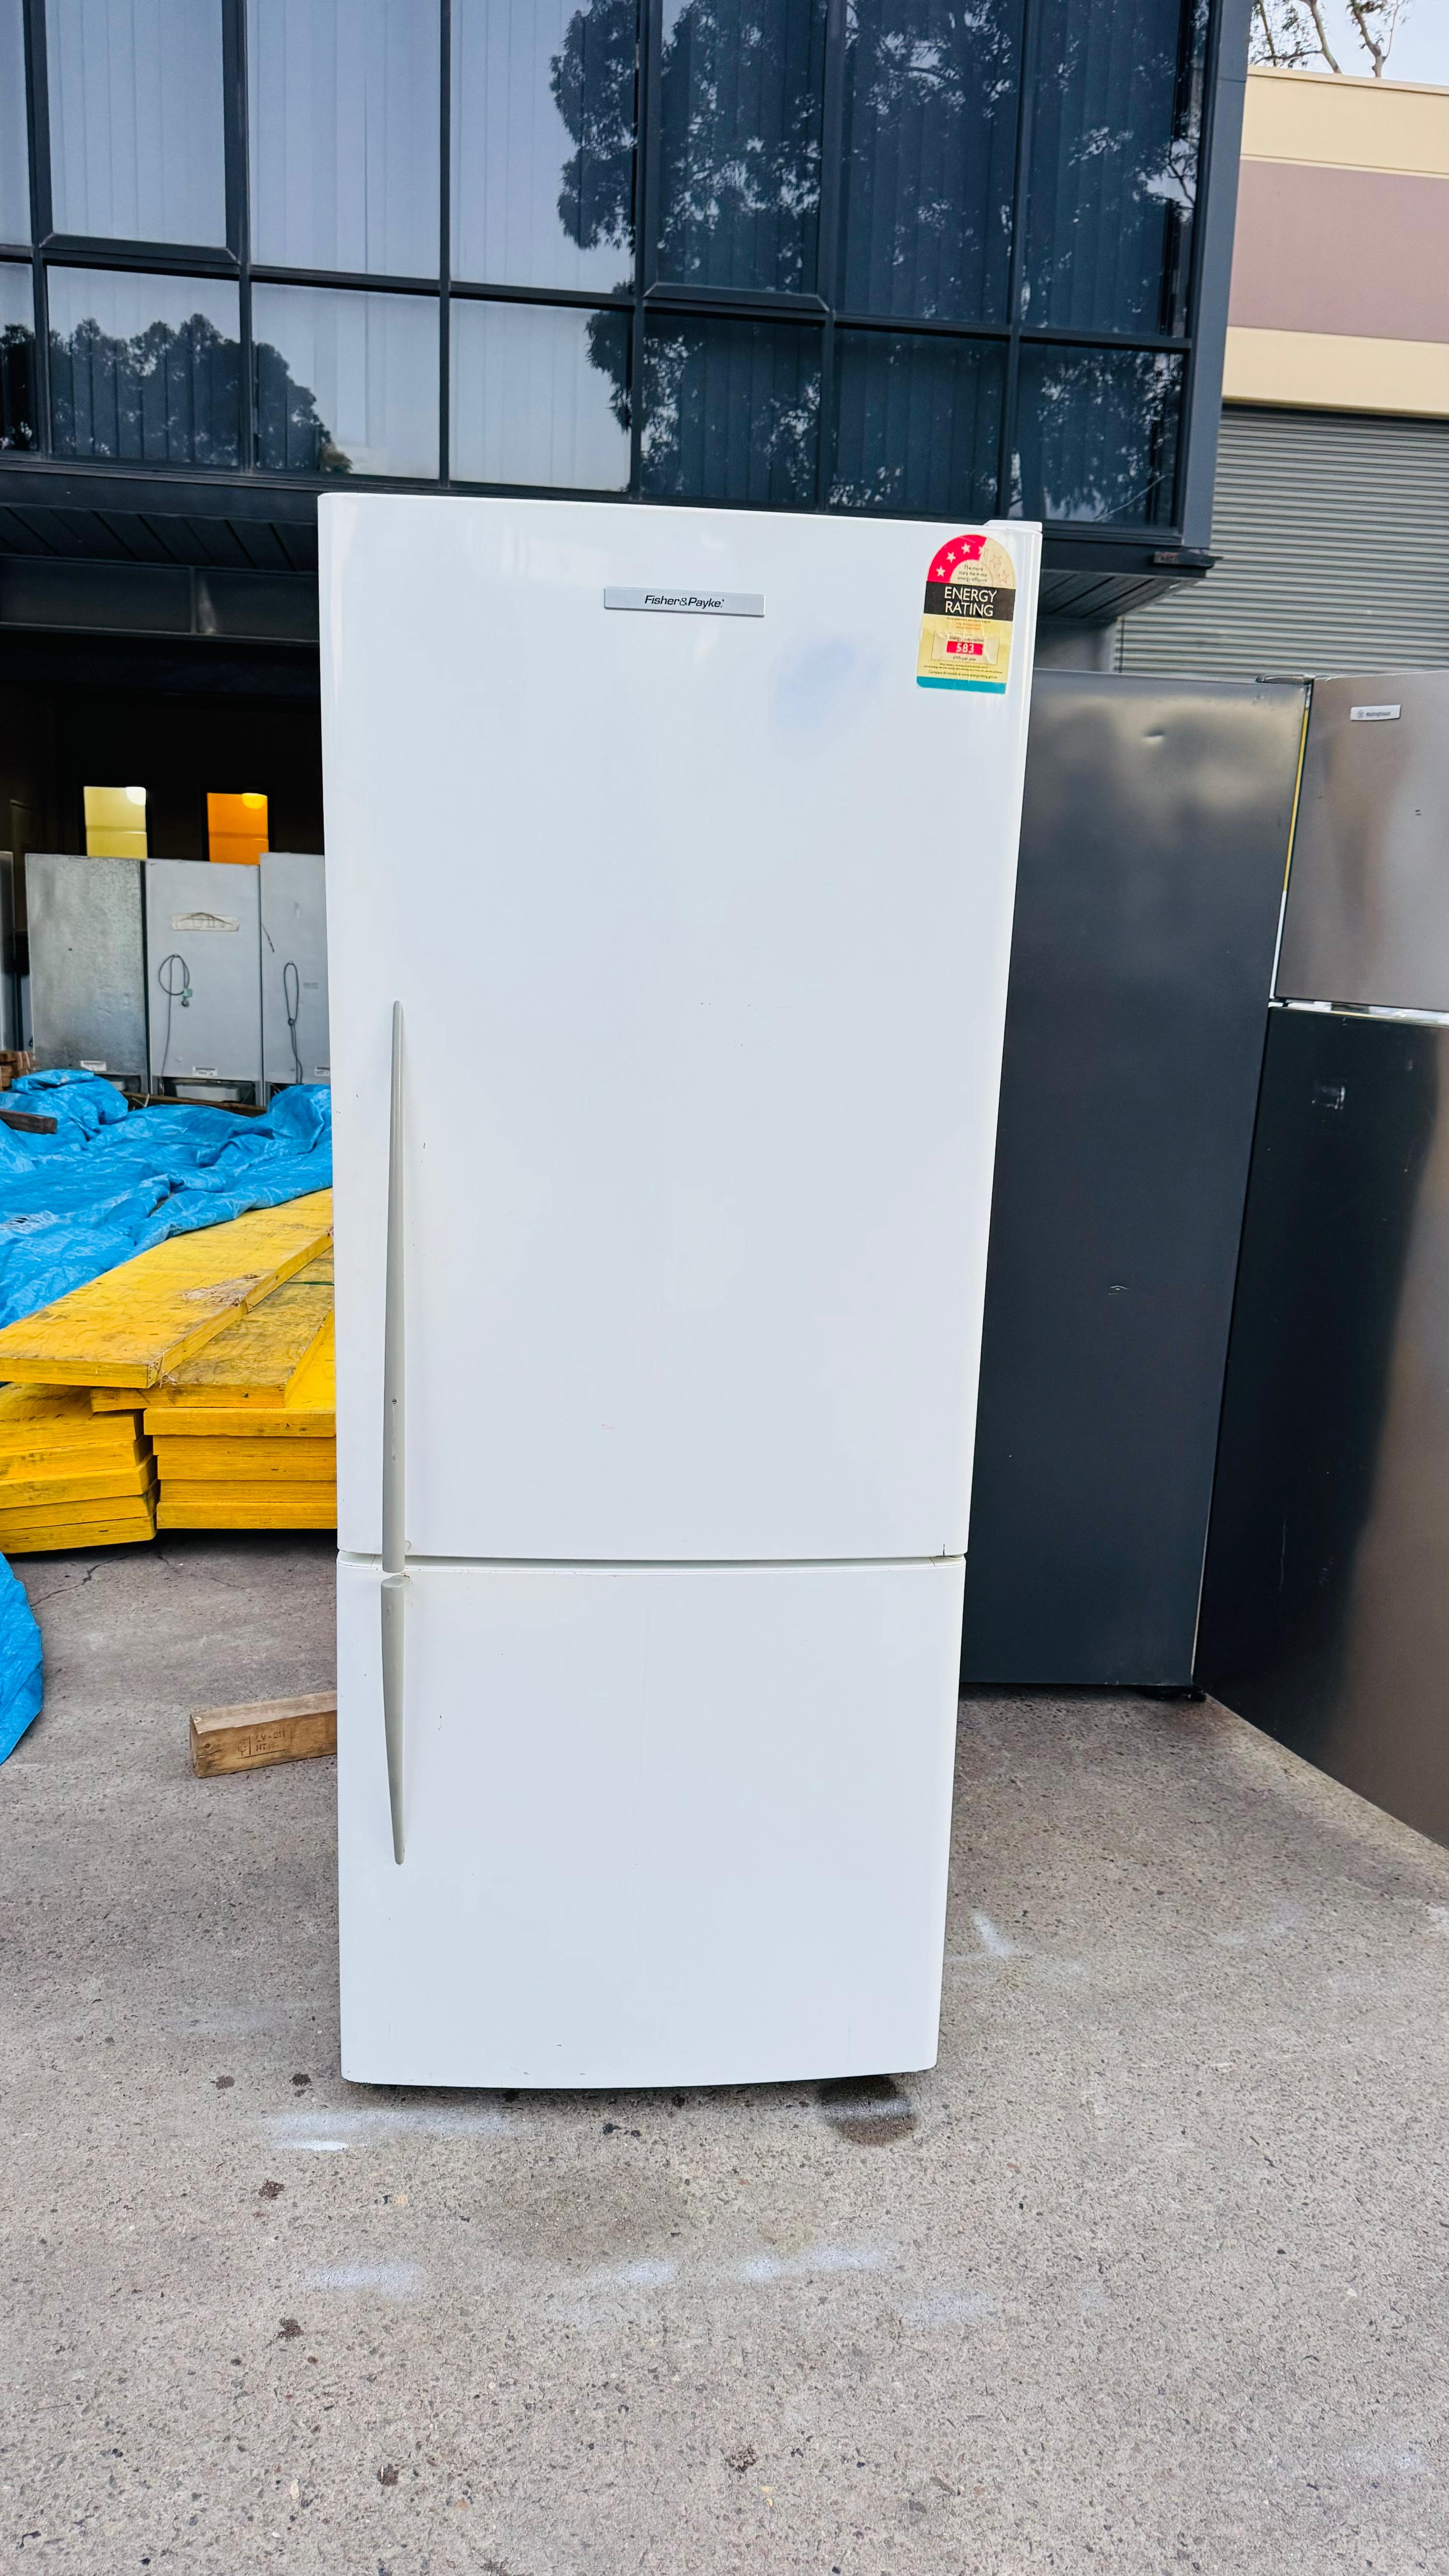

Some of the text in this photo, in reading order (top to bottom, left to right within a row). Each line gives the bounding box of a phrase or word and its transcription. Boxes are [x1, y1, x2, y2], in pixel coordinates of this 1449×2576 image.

[944, 586, 997, 603] ENERGY
[945, 601, 994, 617] RATING
[956, 642, 975, 654] 583
